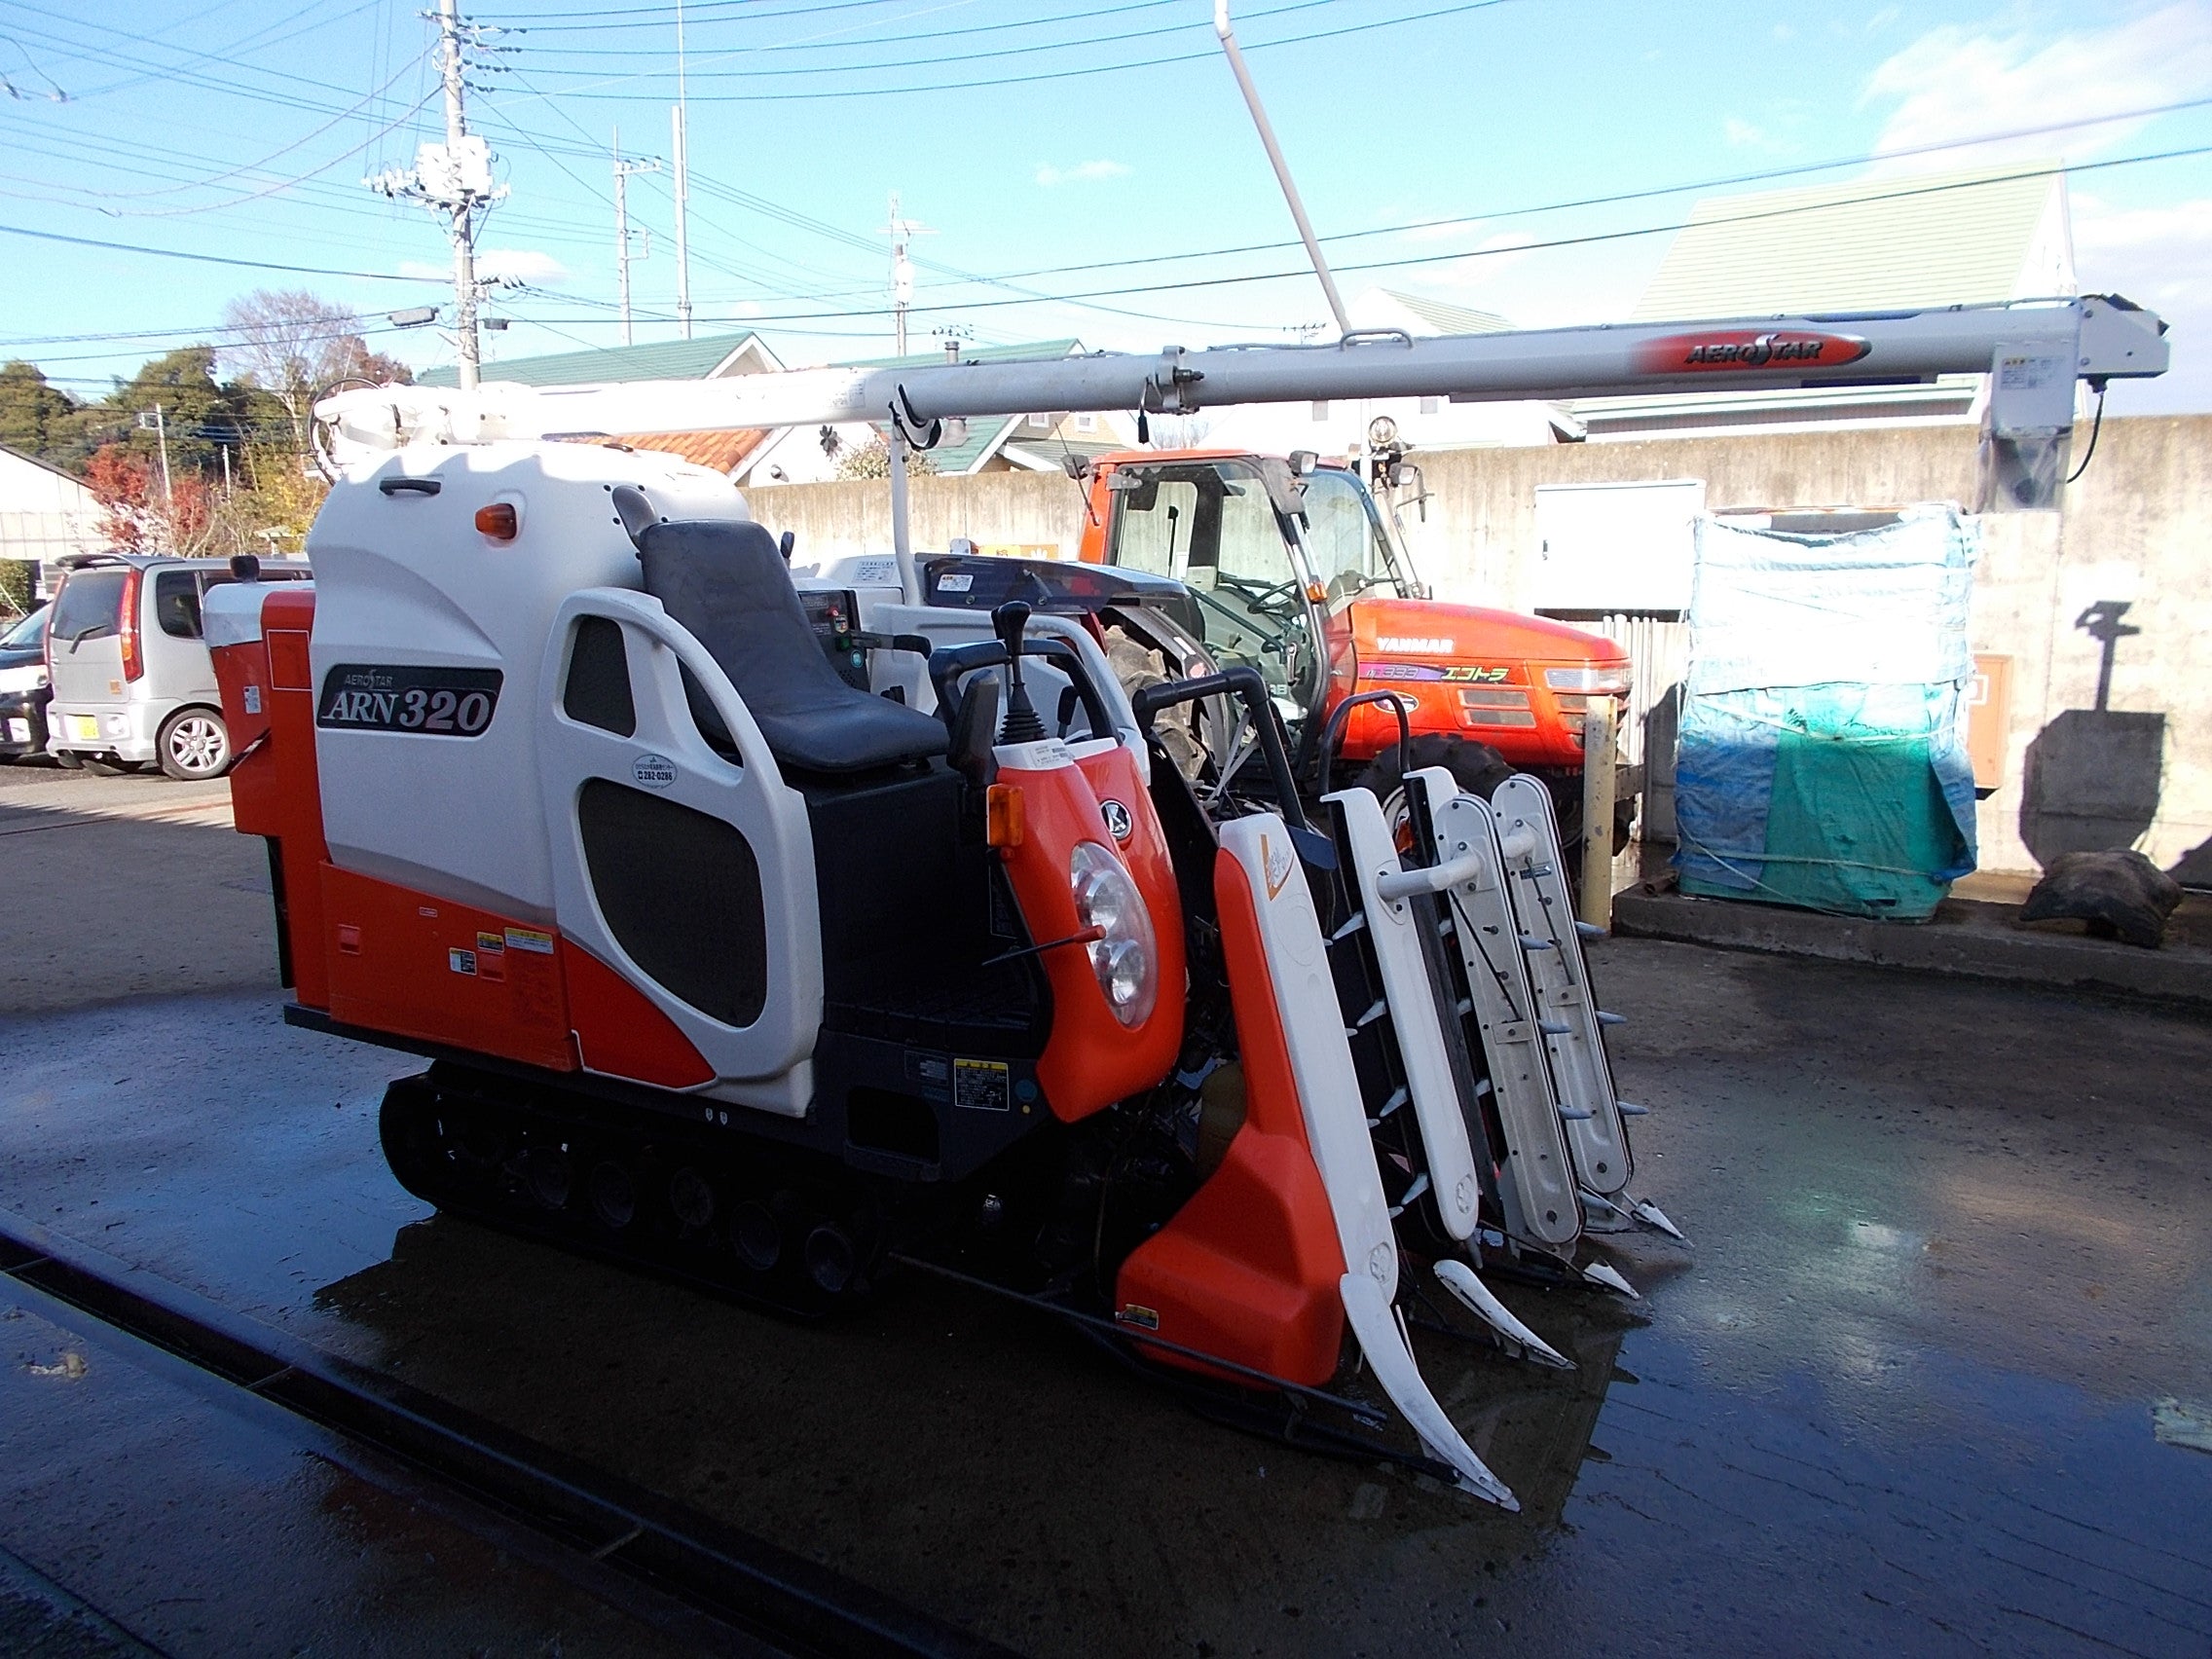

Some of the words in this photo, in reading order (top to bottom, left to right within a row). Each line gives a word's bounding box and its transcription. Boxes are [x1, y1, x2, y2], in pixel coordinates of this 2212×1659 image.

[1684, 334, 1824, 365] AEROSTAR
[1377, 637, 1455, 653] YANMAR
[345, 670, 394, 689] AEROSTAR
[1440, 667, 1510, 682] エコトラ
